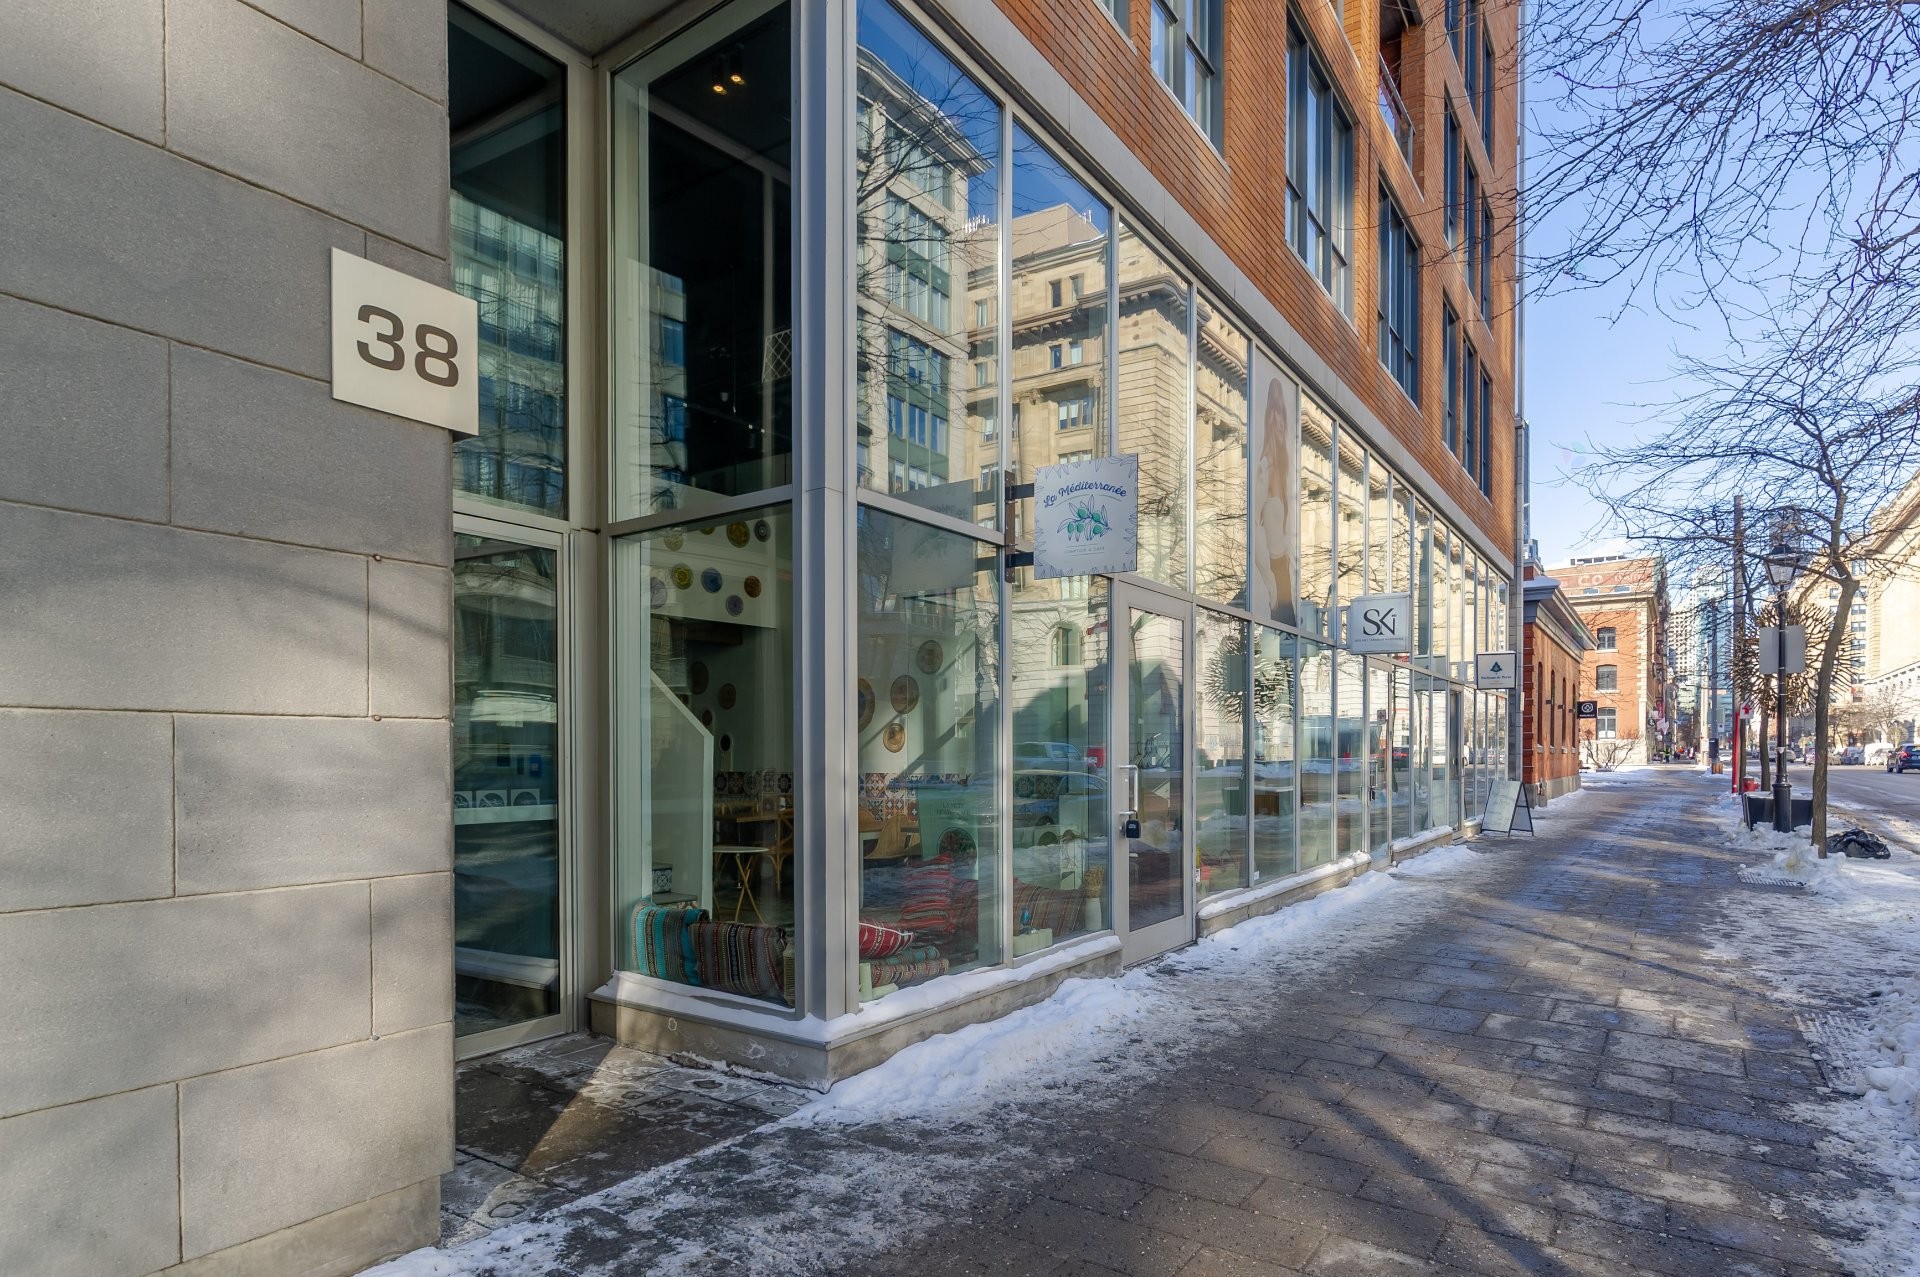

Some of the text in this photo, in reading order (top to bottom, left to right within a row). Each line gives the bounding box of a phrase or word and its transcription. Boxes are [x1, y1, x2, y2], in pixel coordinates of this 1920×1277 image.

[357, 304, 459, 387] 38
[1043, 481, 1127, 508] La Méditerranée
